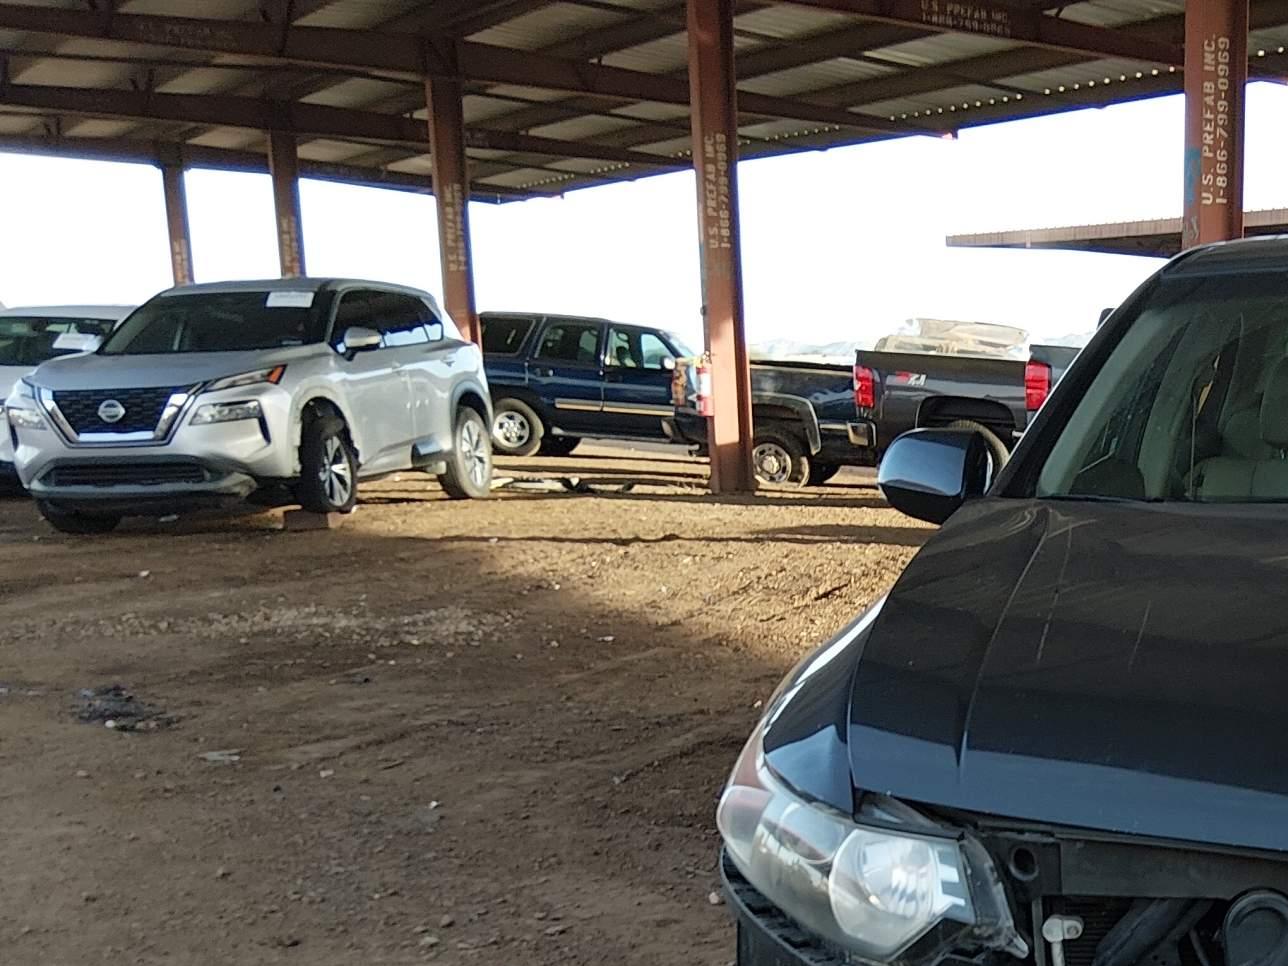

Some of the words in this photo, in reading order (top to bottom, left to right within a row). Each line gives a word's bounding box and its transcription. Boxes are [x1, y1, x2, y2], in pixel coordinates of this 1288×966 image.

[1203, 33, 1216, 71] INC.
[1202, 80, 1216, 158] PREFAB
[1216, 36, 1230, 205] 1-866-799-0969
[705, 163, 718, 217] PREFAB
[1201, 168, 1215, 205] U.S.
